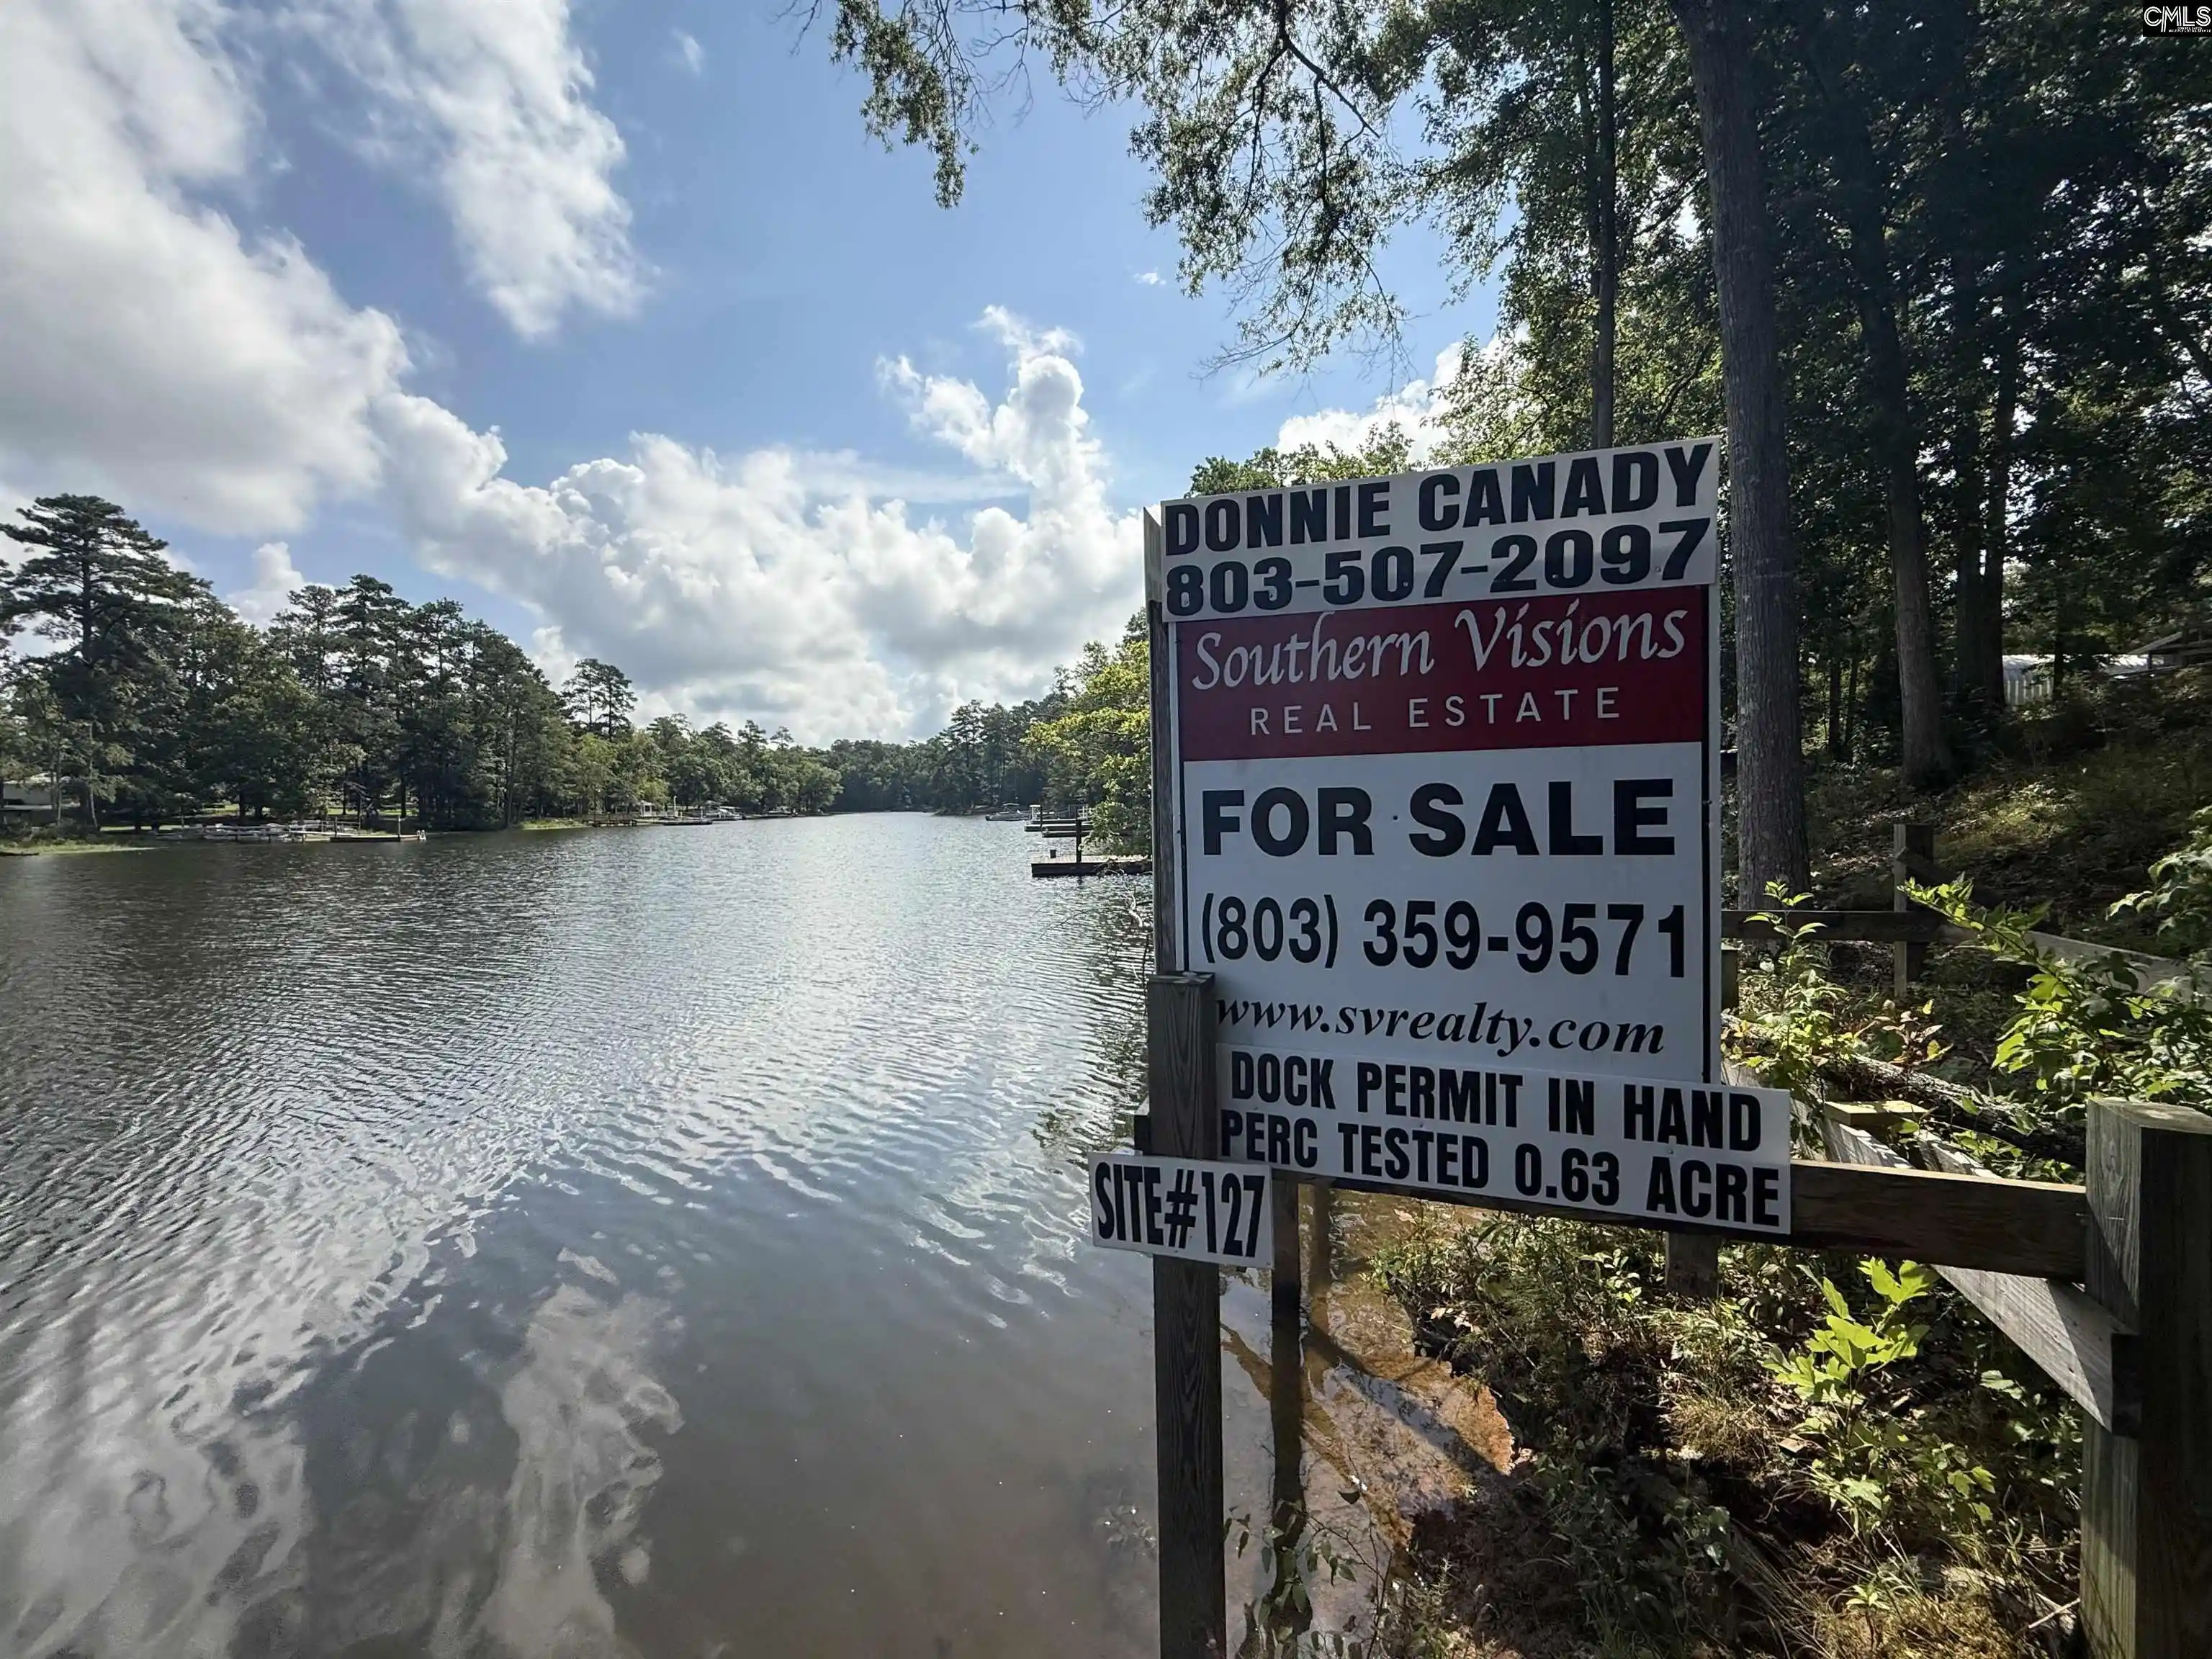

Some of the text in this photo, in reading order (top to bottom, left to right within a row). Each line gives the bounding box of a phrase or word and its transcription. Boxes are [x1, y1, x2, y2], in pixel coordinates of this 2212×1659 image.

[1165, 444, 1713, 555] DONNIE CANADY
[1166, 517, 1711, 616] 803-507-2097
[1192, 598, 1688, 690] Southern Visions
[1251, 687, 1619, 736] REAL ESTATE
[1202, 778, 1675, 857] FOR SALE
[1202, 893, 1685, 978] (803) 359-9571
[1217, 998, 1664, 1057] www.svrealty.com
[1232, 1051, 1762, 1152] DOCK PERMIT IN HAND
[1094, 1161, 1265, 1258] SITE#127
[1220, 1109, 1780, 1226] PERC TESTED 0.63 ACRE
